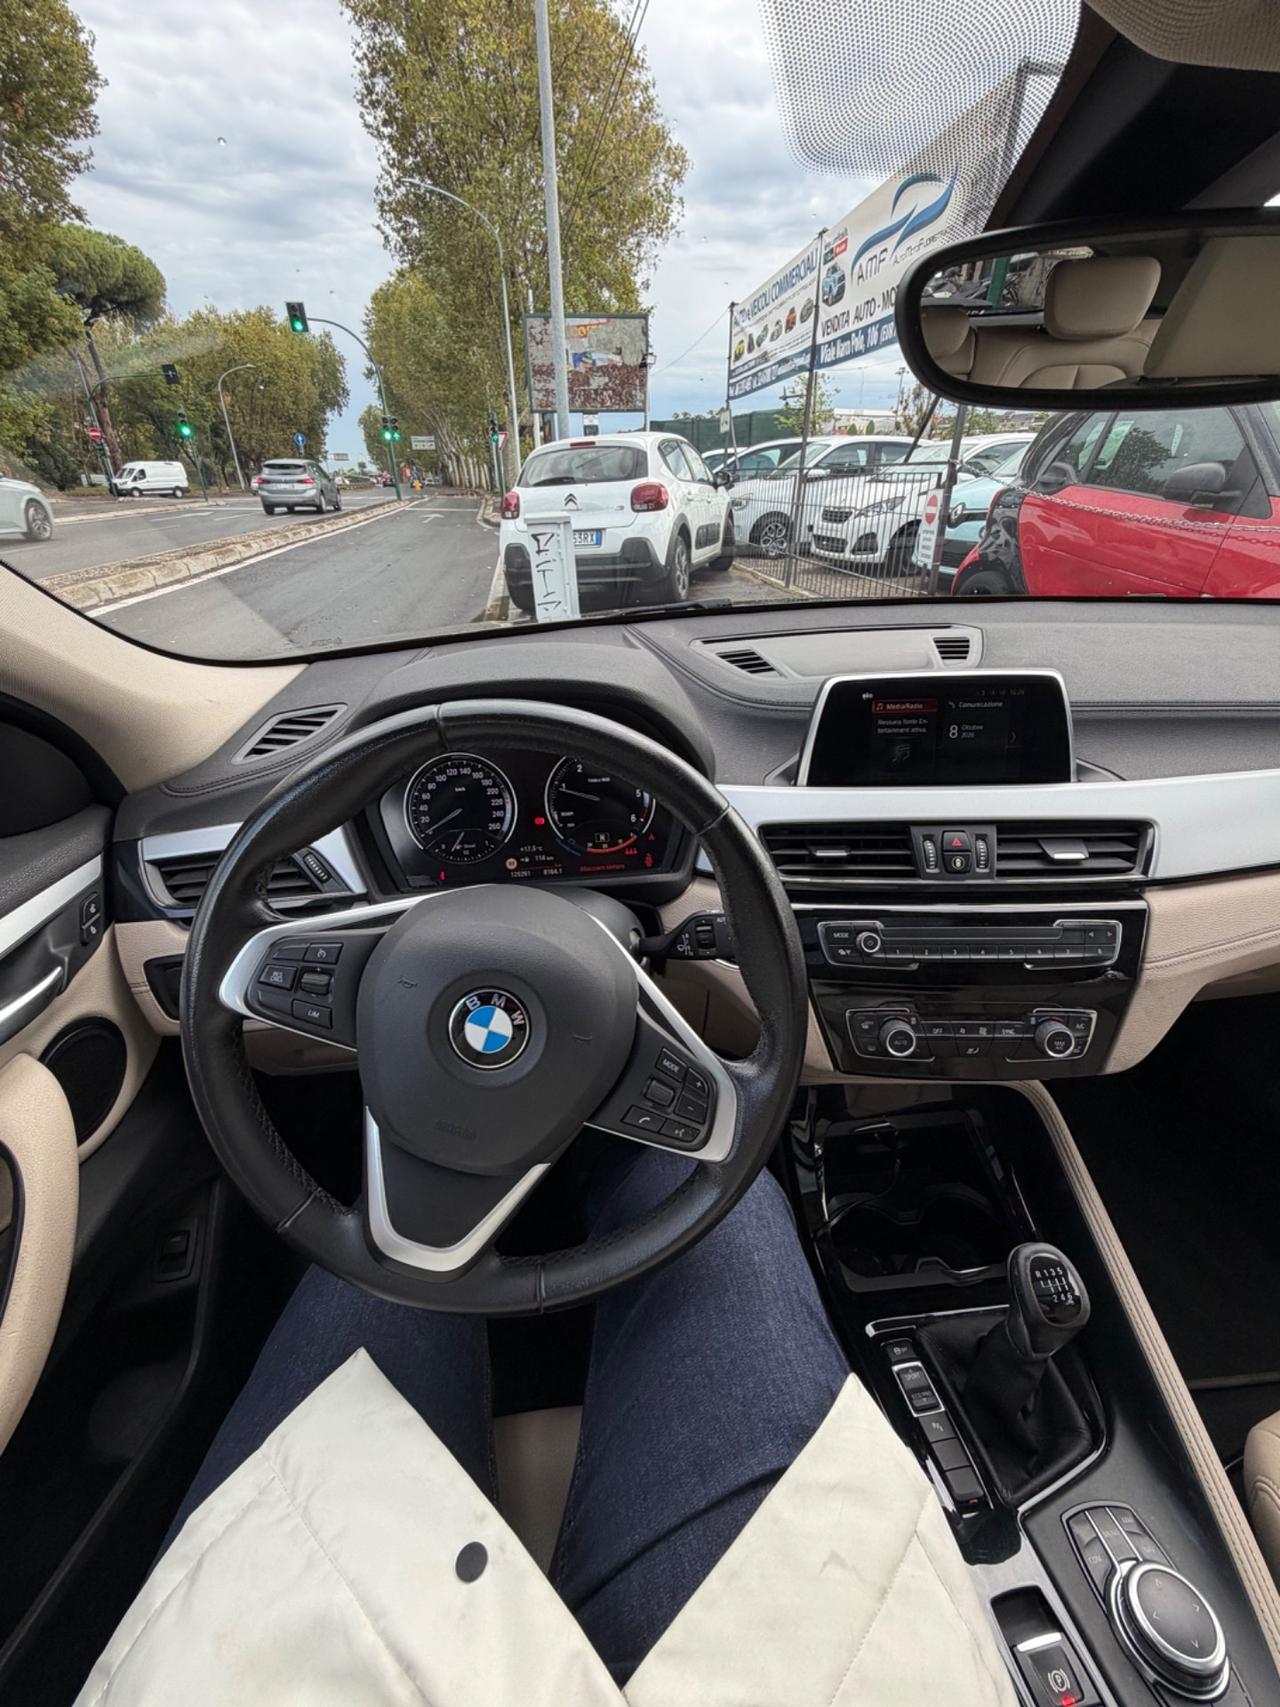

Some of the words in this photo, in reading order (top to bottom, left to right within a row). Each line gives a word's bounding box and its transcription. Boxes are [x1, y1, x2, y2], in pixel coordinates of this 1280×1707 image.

[857, 247, 888, 286] AMF
[771, 247, 819, 303] COMMERCIALI
[821, 309, 850, 338] VENDITA
[853, 297, 877, 325] AUTO
[881, 284, 900, 312] MO
[949, 724, 958, 739] 8
[446, 767, 458, 776] 120
[460, 767, 472, 775] 140
[576, 763, 583, 773] 2
[434, 774, 447, 782] 100
[427, 782, 436, 790] 80
[486, 787, 499, 795] 200
[421, 792, 431, 800] 60
[635, 788, 642, 798] 5
[492, 810, 504, 818] 240
[630, 813, 637, 823] 6
[420, 816, 430, 824] 20
[488, 822, 501, 831] 260
[465, 993, 525, 1026] BMW
[662, 1058, 680, 1073] MODE
[1035, 1270, 1041, 1279] R
[1043, 1269, 1049, 1277] 1
[1050, 1268, 1056, 1276] 3
[1056, 1266, 1063, 1275] 5
[1053, 1294, 1059, 1303] 2
[1060, 1293, 1066, 1301] 4
